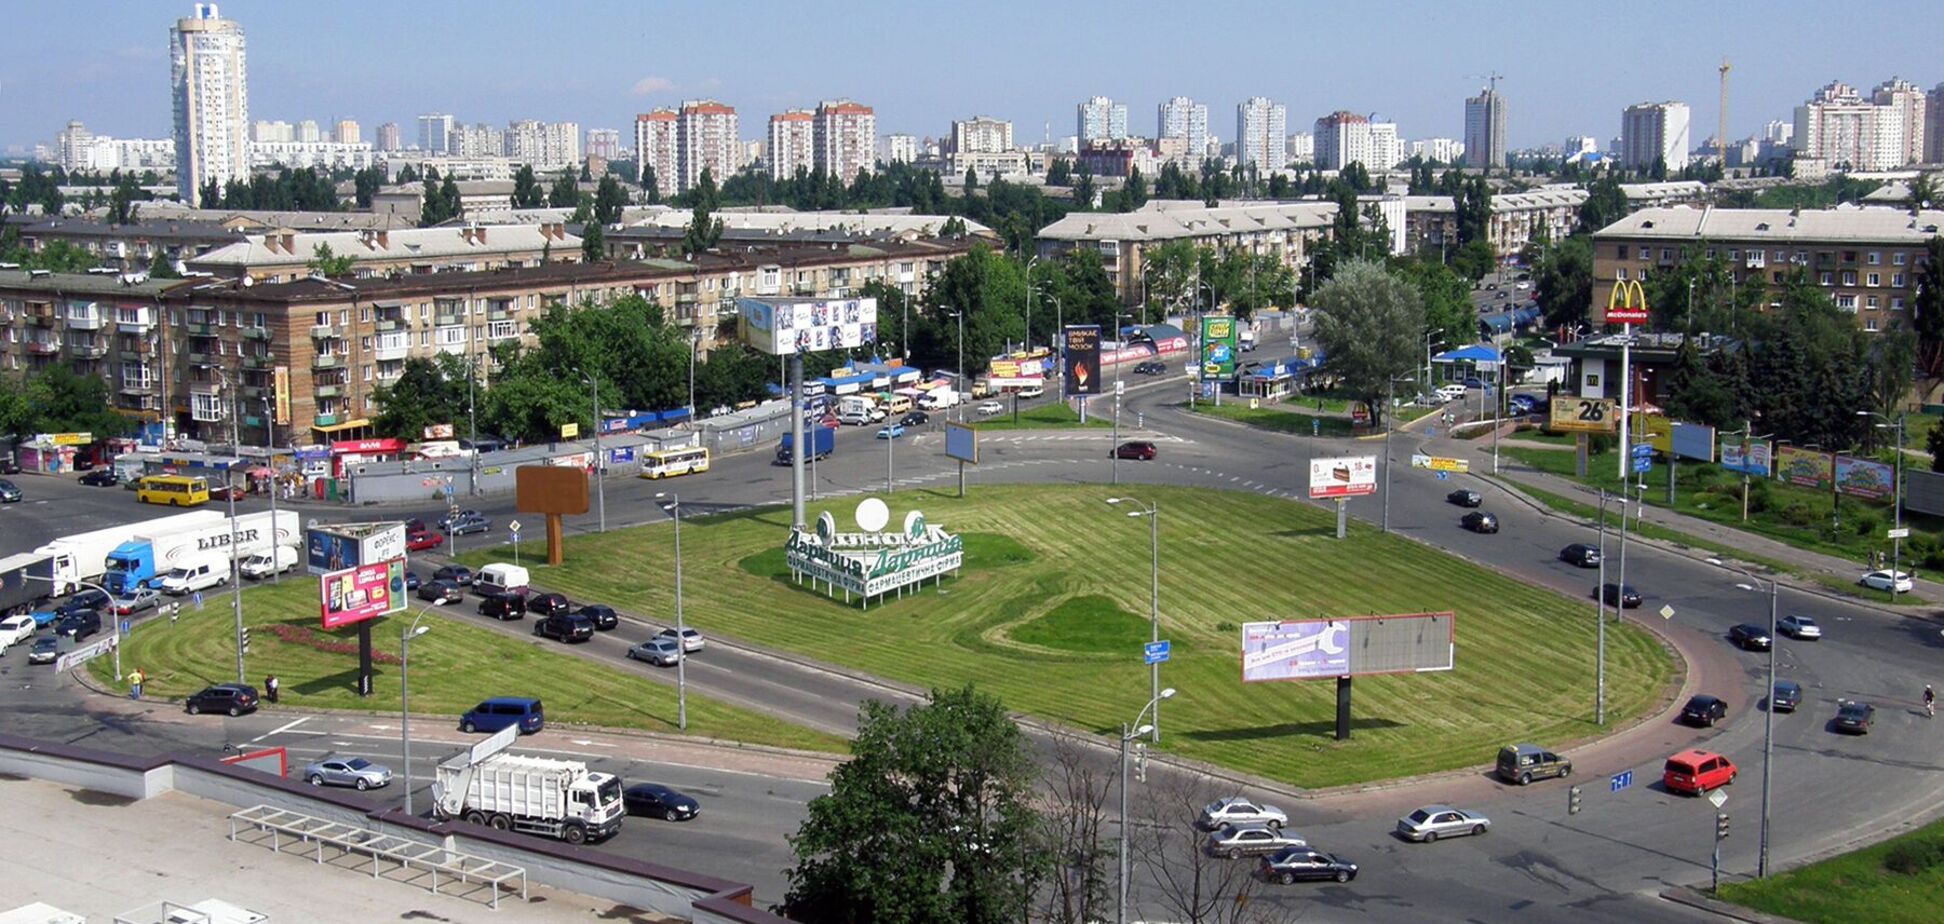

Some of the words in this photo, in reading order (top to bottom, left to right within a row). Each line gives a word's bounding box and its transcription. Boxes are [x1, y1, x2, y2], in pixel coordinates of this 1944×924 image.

[197, 529, 259, 551] LIBER
[868, 534, 962, 579] Дарниця
[787, 555, 842, 585] ФАРМАЦЕВТИЧНА
[868, 564, 935, 593] ФАРМАЦЕВТИЧНА
[937, 555, 960, 571] ФІРМА
